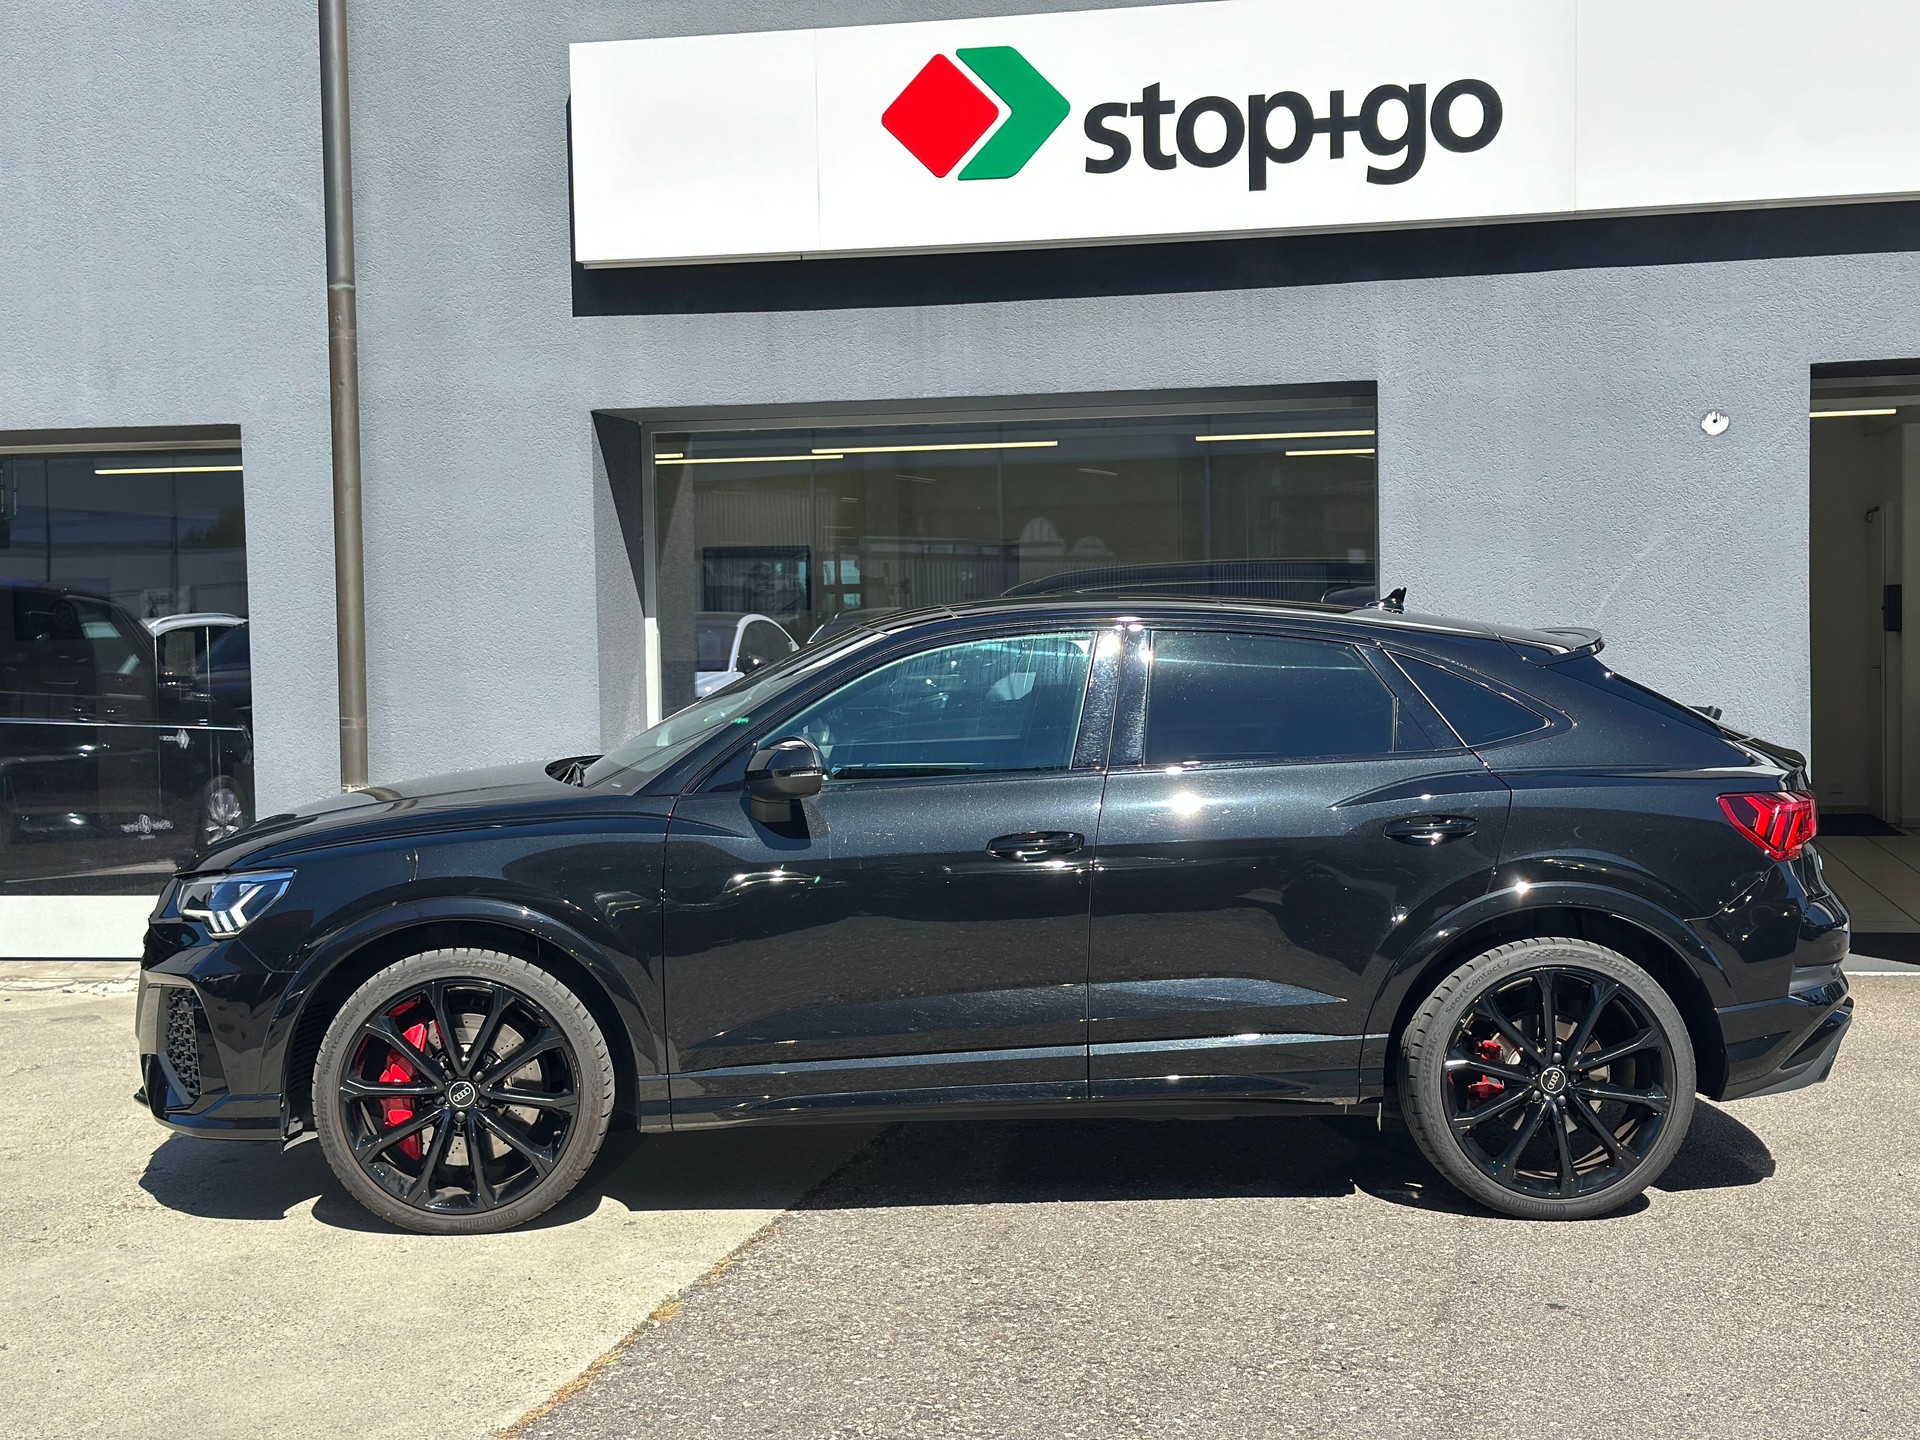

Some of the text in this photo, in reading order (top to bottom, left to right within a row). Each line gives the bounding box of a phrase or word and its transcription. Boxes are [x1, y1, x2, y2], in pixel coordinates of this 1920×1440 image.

[1084, 79, 1502, 191] stop+go
[531, 981, 565, 1010] 255/35
[563, 1010, 576, 1025] ZR
[1445, 964, 1502, 1014] SportContact
[323, 1006, 360, 1075] SportContact
